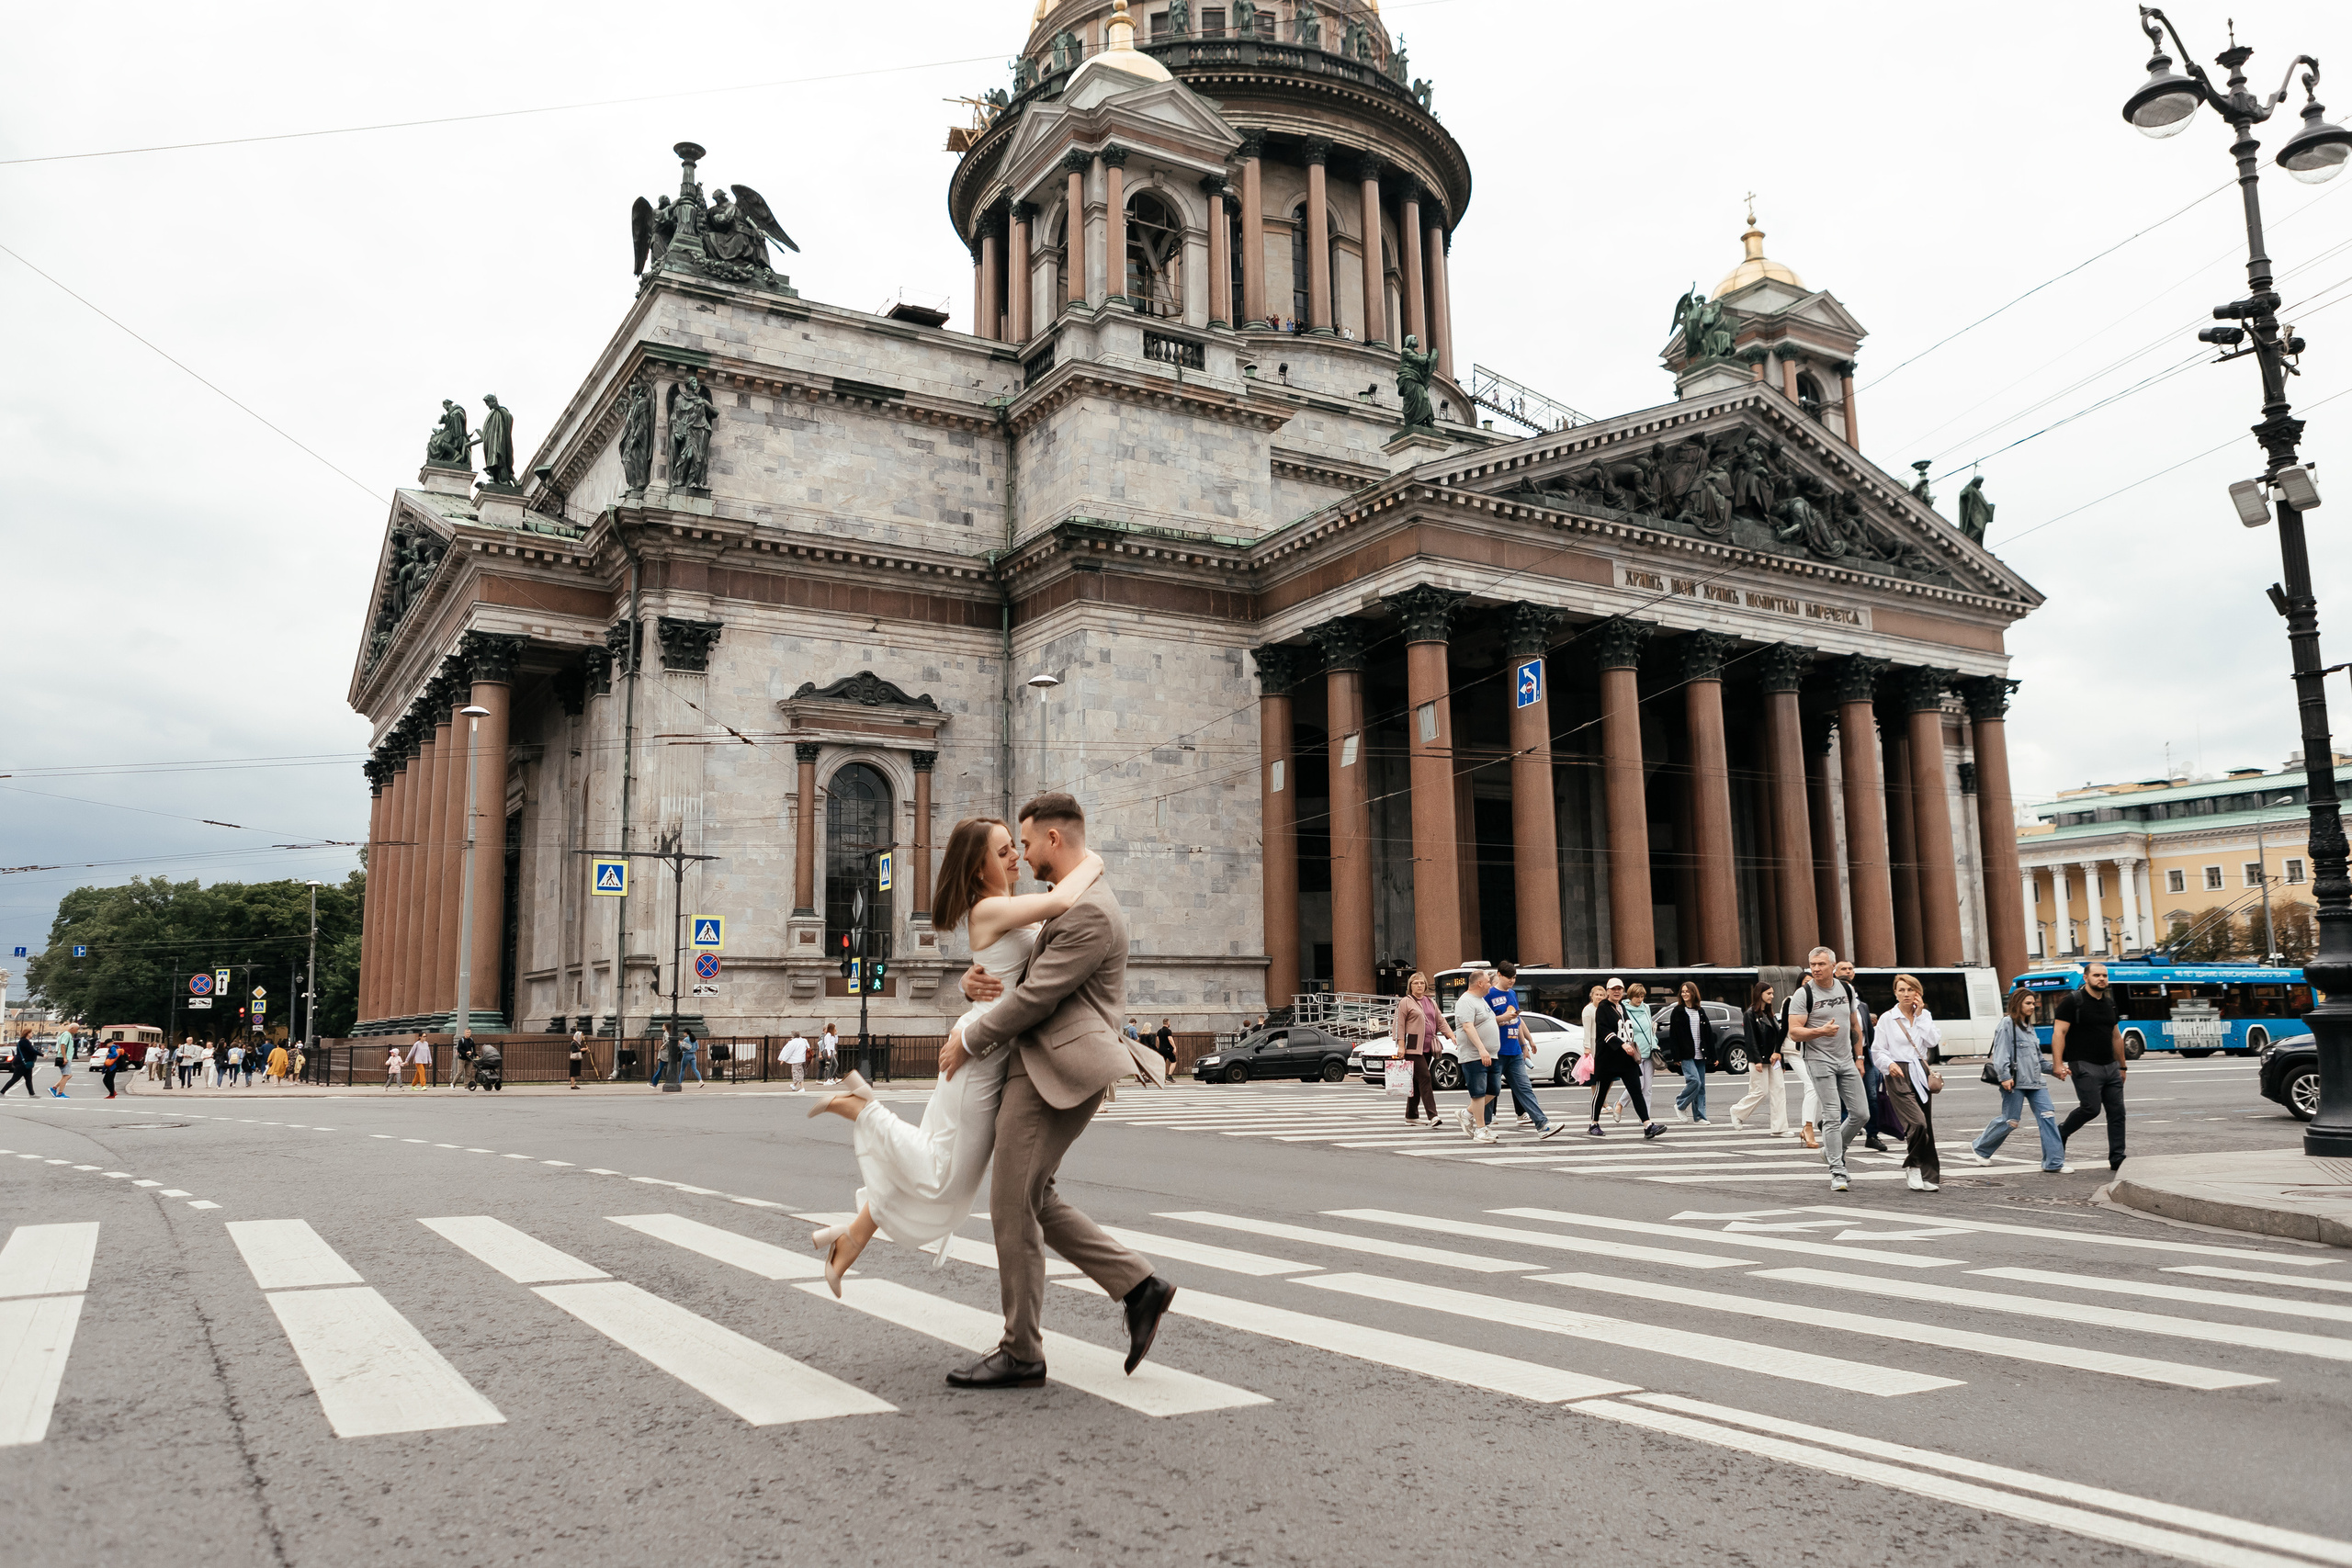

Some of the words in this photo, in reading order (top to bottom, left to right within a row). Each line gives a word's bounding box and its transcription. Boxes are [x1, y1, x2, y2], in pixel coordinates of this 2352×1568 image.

[1625, 570, 1664, 592] ХРАМЪ
[1703, 584, 1739, 604] ХРАМЪ
[876, 964, 883, 975] 9
